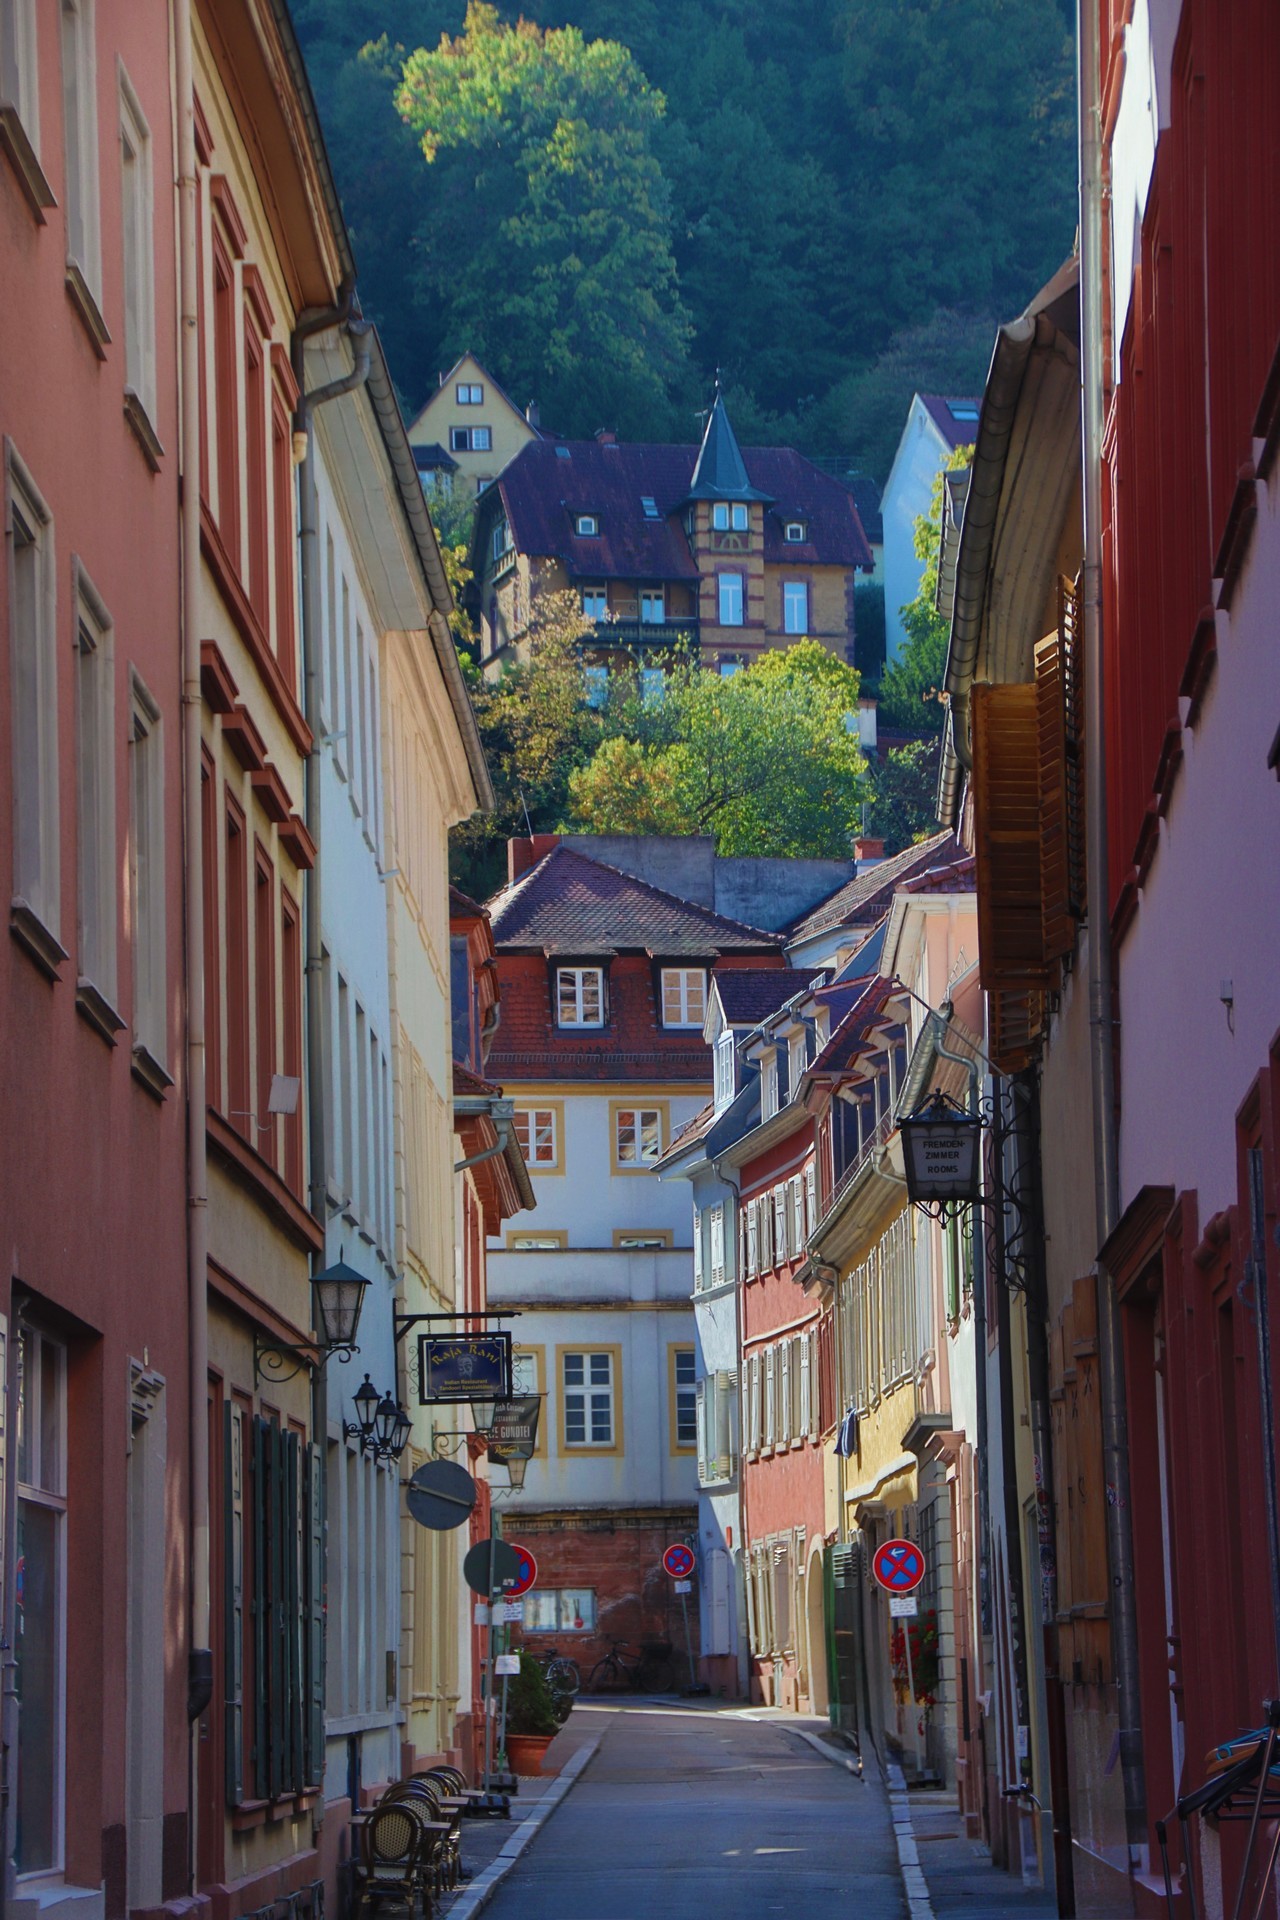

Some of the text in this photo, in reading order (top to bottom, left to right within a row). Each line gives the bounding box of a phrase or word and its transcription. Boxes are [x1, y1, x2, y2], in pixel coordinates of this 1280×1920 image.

[923, 1140, 966, 1149] FREMDEN-
[925, 1151, 960, 1160] ZIMMER
[927, 1165, 959, 1174] ROOMS
[431, 1344, 500, 1366] Raja Rani
